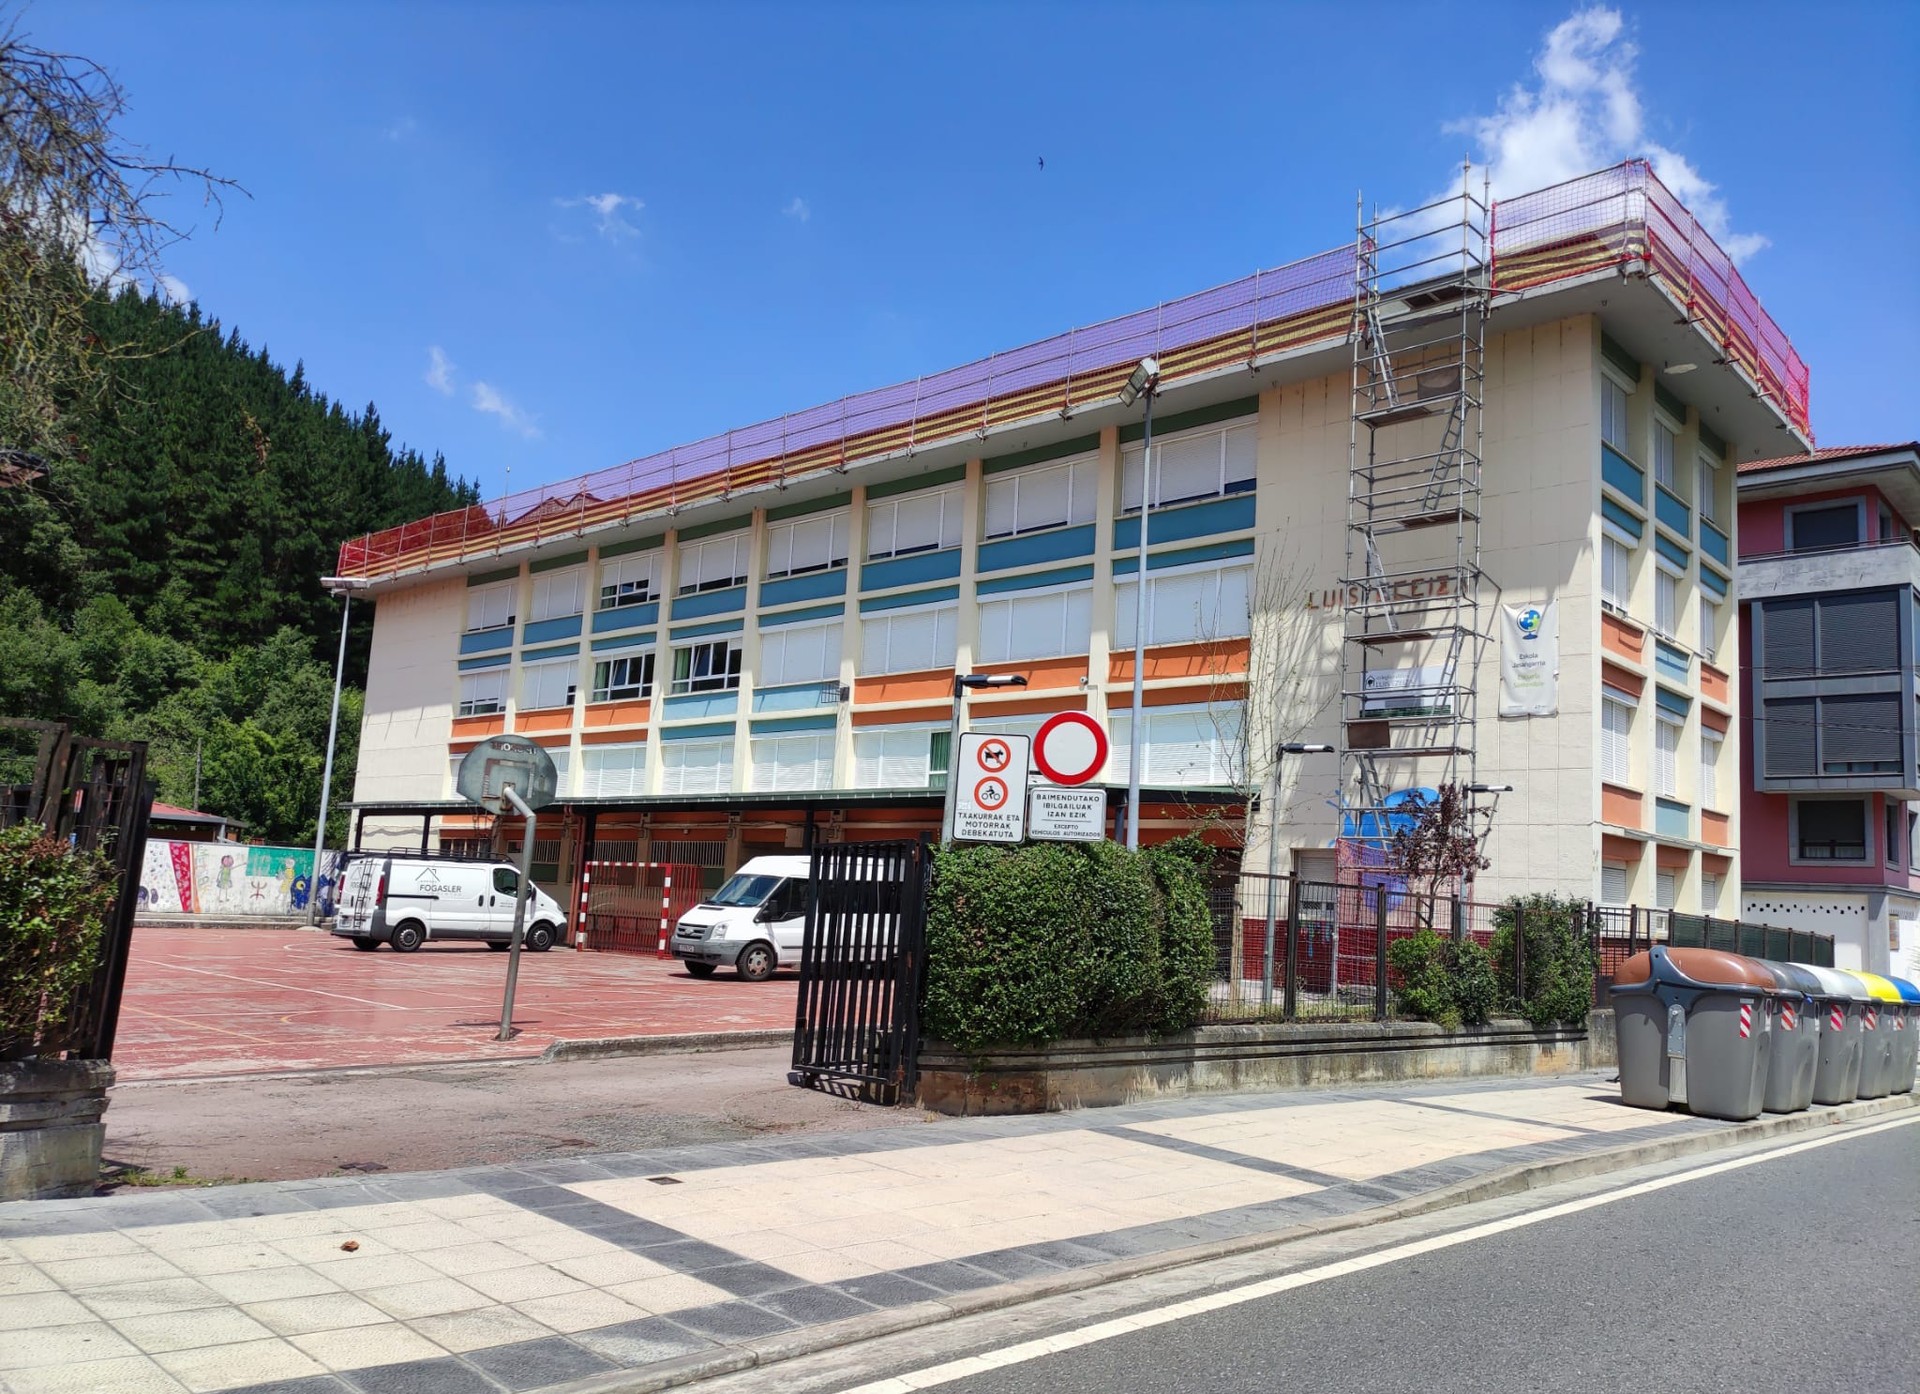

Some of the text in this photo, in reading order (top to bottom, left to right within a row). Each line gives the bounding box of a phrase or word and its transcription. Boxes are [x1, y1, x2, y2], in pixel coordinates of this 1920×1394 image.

[1309, 586, 1359, 609] LUIS
[1036, 794, 1100, 802] BAIMENDUTAKO
[958, 812, 1004, 820] TXAKURRAK
[965, 821, 1011, 829] MOTORRAK
[961, 829, 1014, 838] DEBEKATUTA
[419, 884, 462, 893] FOGASLER
